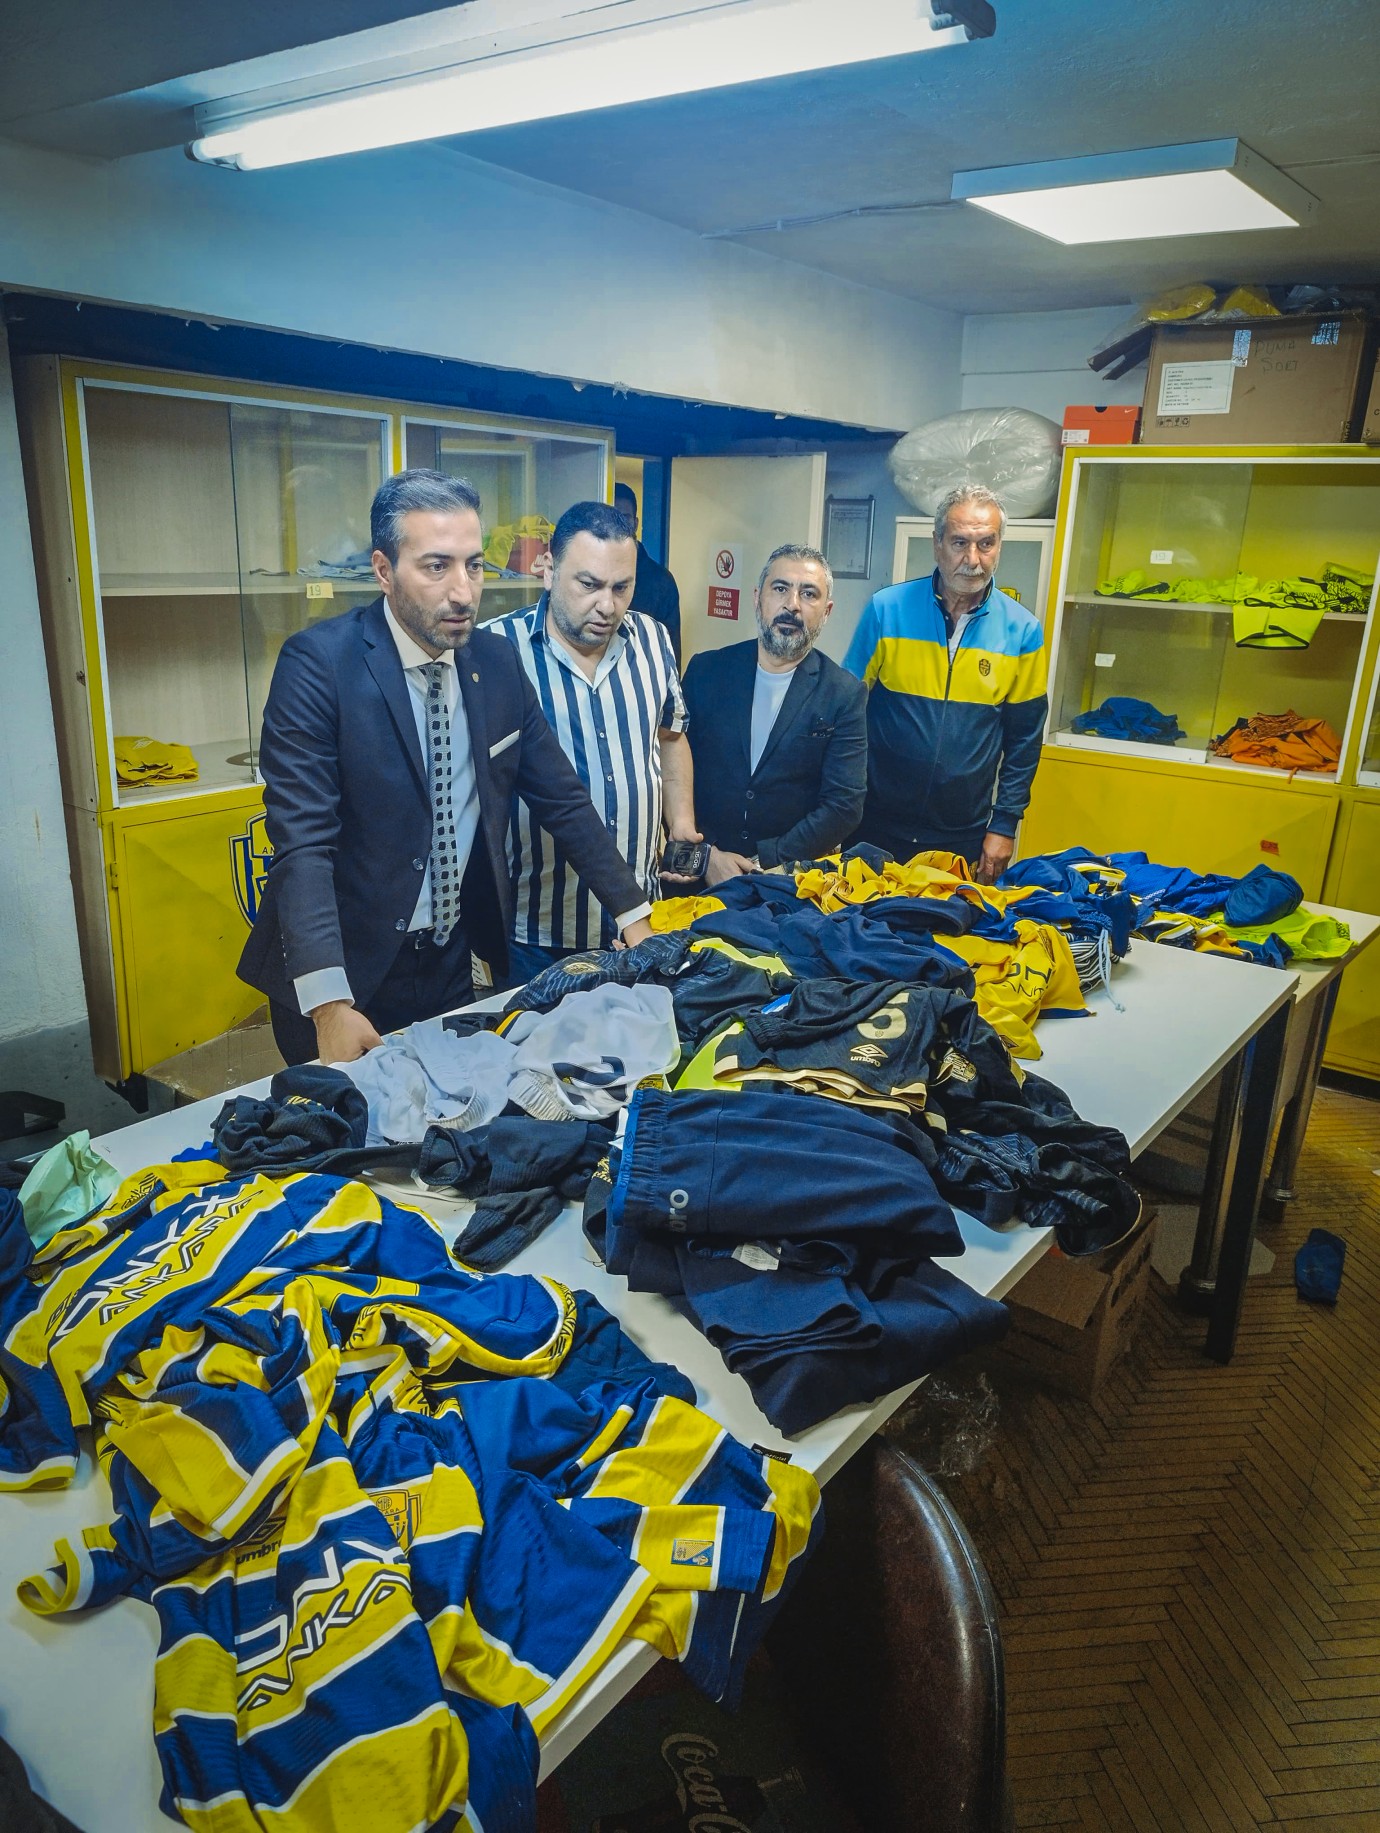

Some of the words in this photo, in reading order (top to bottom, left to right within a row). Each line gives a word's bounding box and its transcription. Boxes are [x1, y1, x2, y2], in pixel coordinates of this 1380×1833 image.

[850, 1055, 881, 1068] umbro
[55, 1191, 250, 1338] ONYX
[236, 1571, 413, 1713] ANKA
